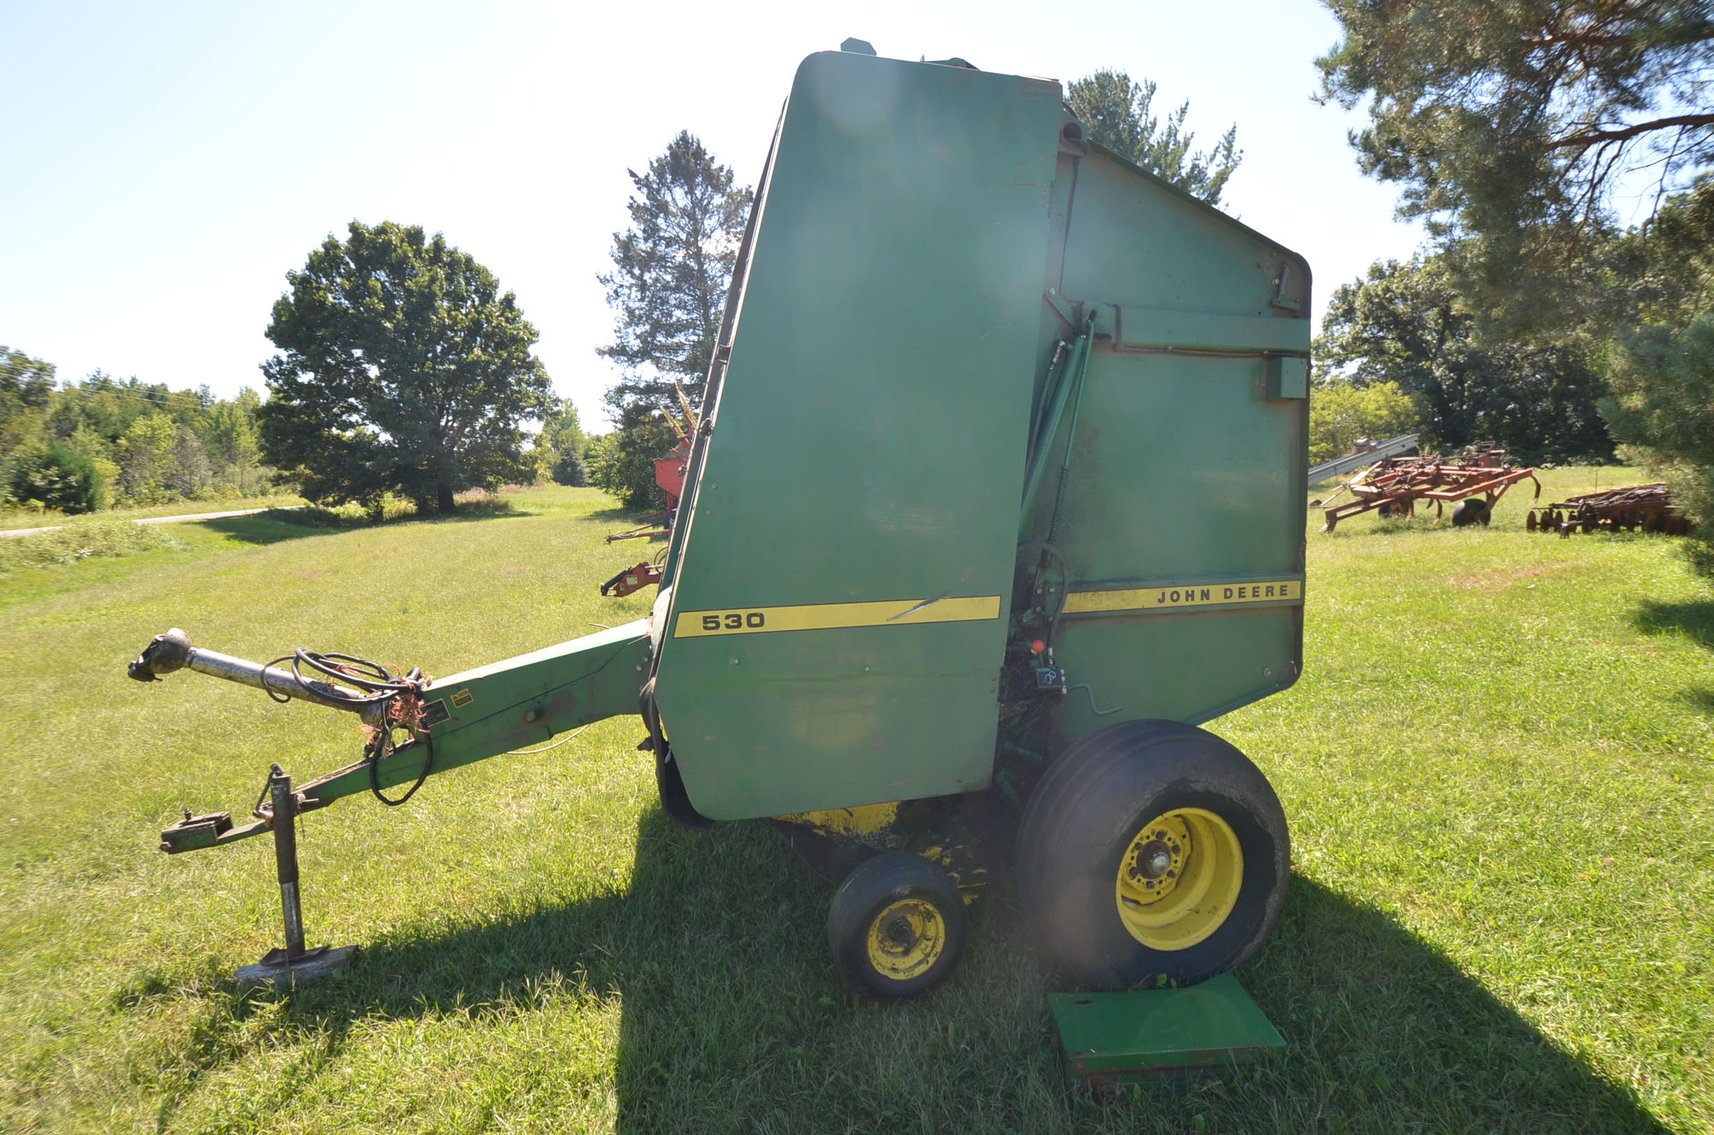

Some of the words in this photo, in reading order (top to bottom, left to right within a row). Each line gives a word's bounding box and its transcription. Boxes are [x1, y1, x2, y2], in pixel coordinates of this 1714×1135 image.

[1157, 589, 1210, 604] JOHN
[1223, 585, 1289, 600] DEERE
[702, 612, 765, 631] 530
